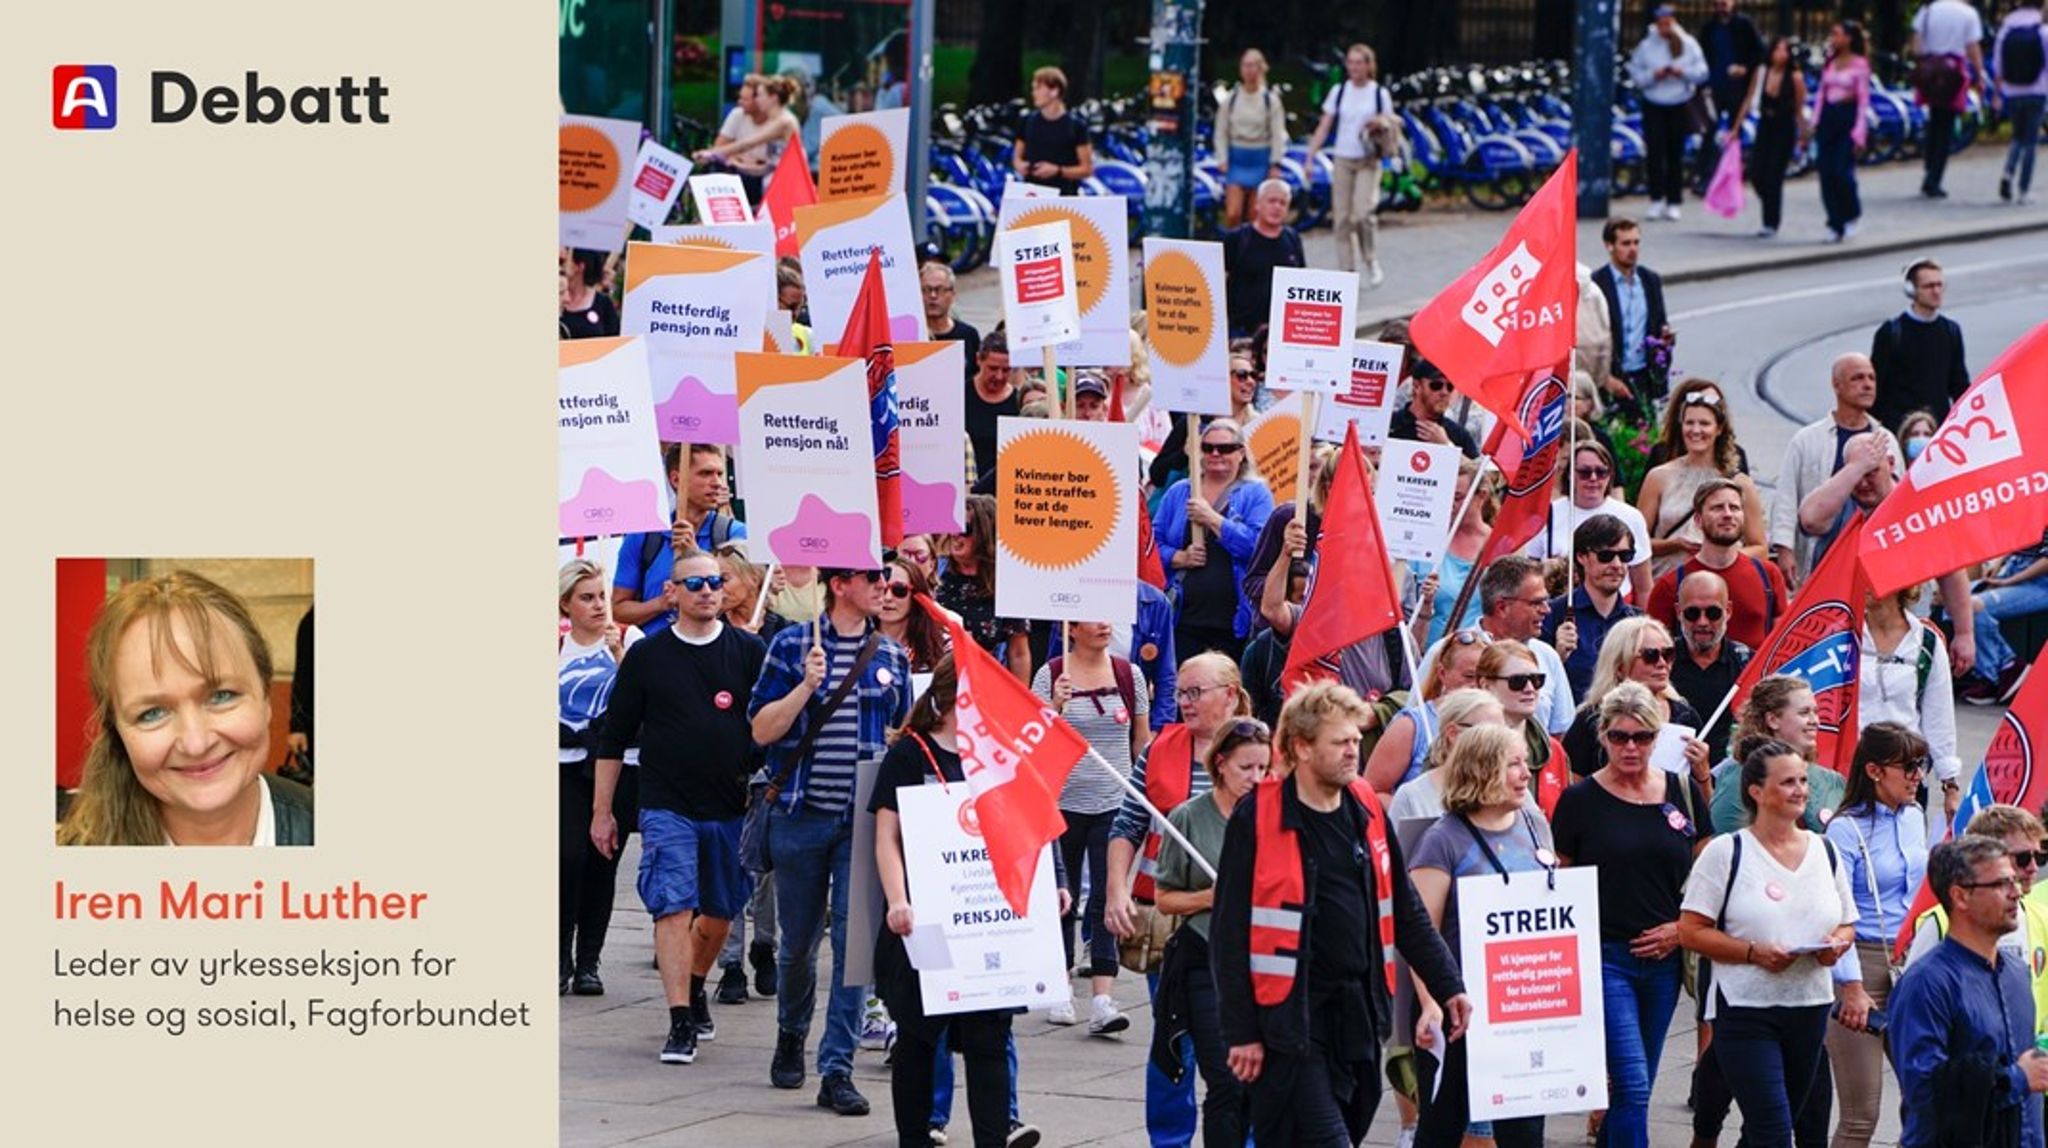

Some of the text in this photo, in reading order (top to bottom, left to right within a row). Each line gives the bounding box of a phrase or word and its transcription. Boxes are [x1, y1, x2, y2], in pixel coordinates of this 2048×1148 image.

[1015, 242, 1061, 261] STREIK
[1287, 287, 1342, 303] STREIK
[651, 300, 730, 321] Rettferdig
[650, 320, 738, 338] pensjon nå!
[606, 411, 631, 424] nå!
[763, 413, 838, 433] Rettferdig
[915, 414, 939, 427] nå!
[765, 434, 849, 452] pensjon nå!
[1014, 468, 1065, 482] Kvinner
[1014, 483, 1096, 499] ikke straffes
[1014, 498, 1069, 512] for at de
[1393, 507, 1431, 518] PENSJON
[1014, 514, 1093, 530] lever lenger.
[799, 537, 829, 549] CREO
[1050, 593, 1081, 604] CREO
[942, 851, 957, 864] VI
[1486, 905, 1576, 936] STREIK
[1492, 965, 1573, 983] rettferdig pensjon
[1521, 982, 1554, 996] kvinner
